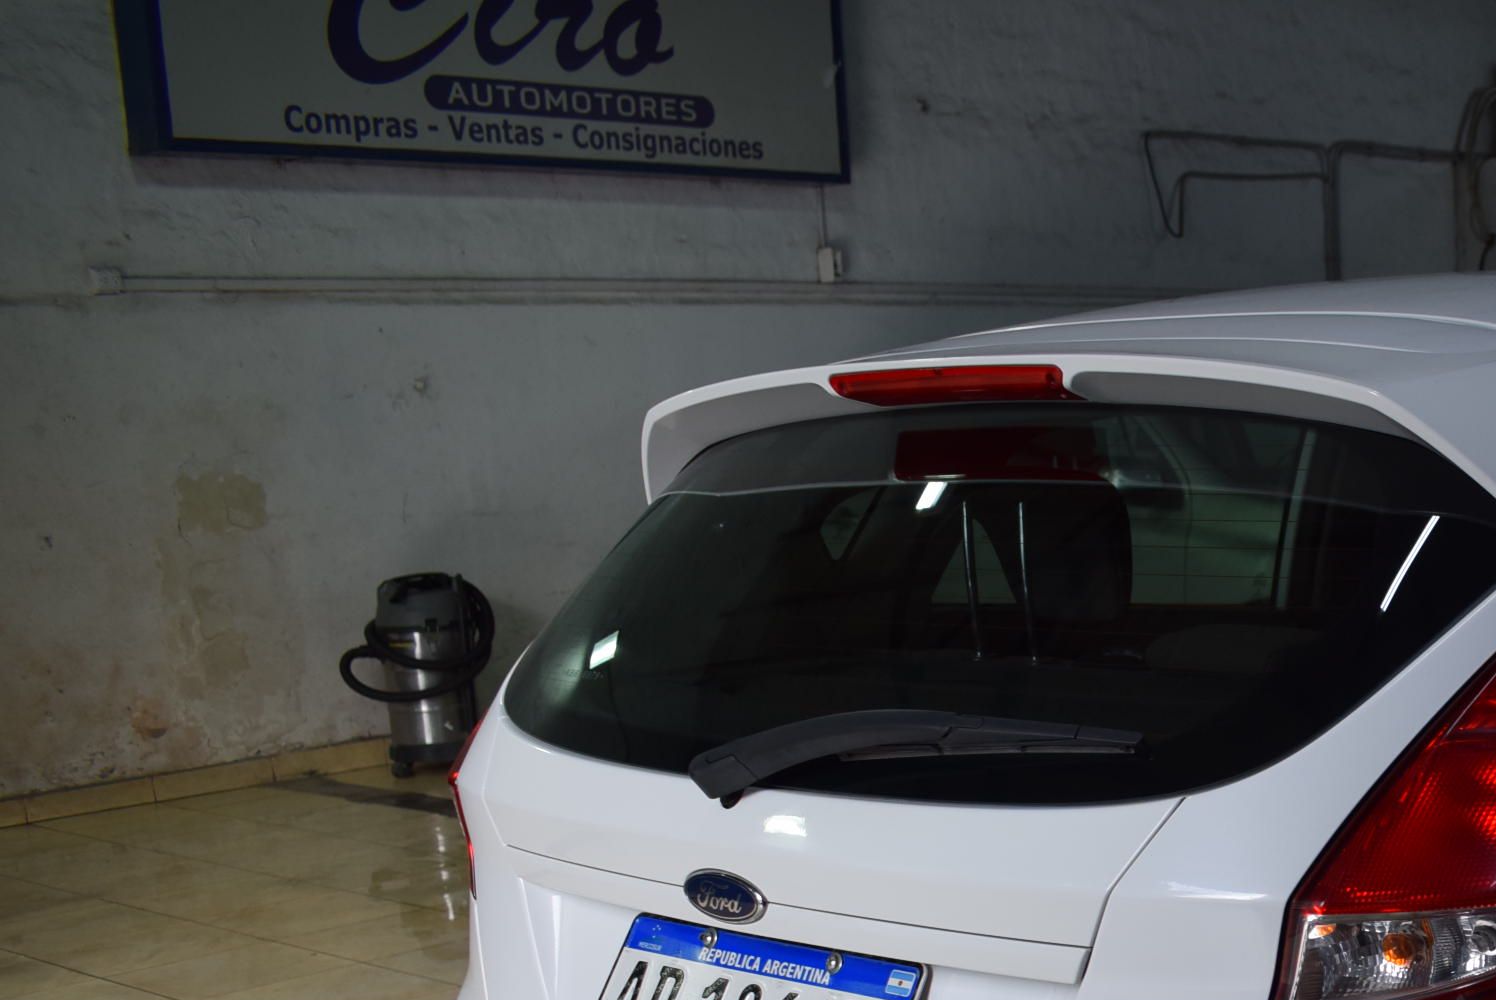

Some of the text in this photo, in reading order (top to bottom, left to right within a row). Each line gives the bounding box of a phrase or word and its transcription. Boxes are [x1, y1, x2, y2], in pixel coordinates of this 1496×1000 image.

[447, 82, 698, 122] AUTOMOTORES
[283, 105, 418, 142] Compras
[449, 115, 545, 147] Ventas
[571, 123, 764, 160] Consignaciones
[696, 880, 743, 914] Ford
[699, 947, 831, 986] REPUBLICA ARGENTINA
